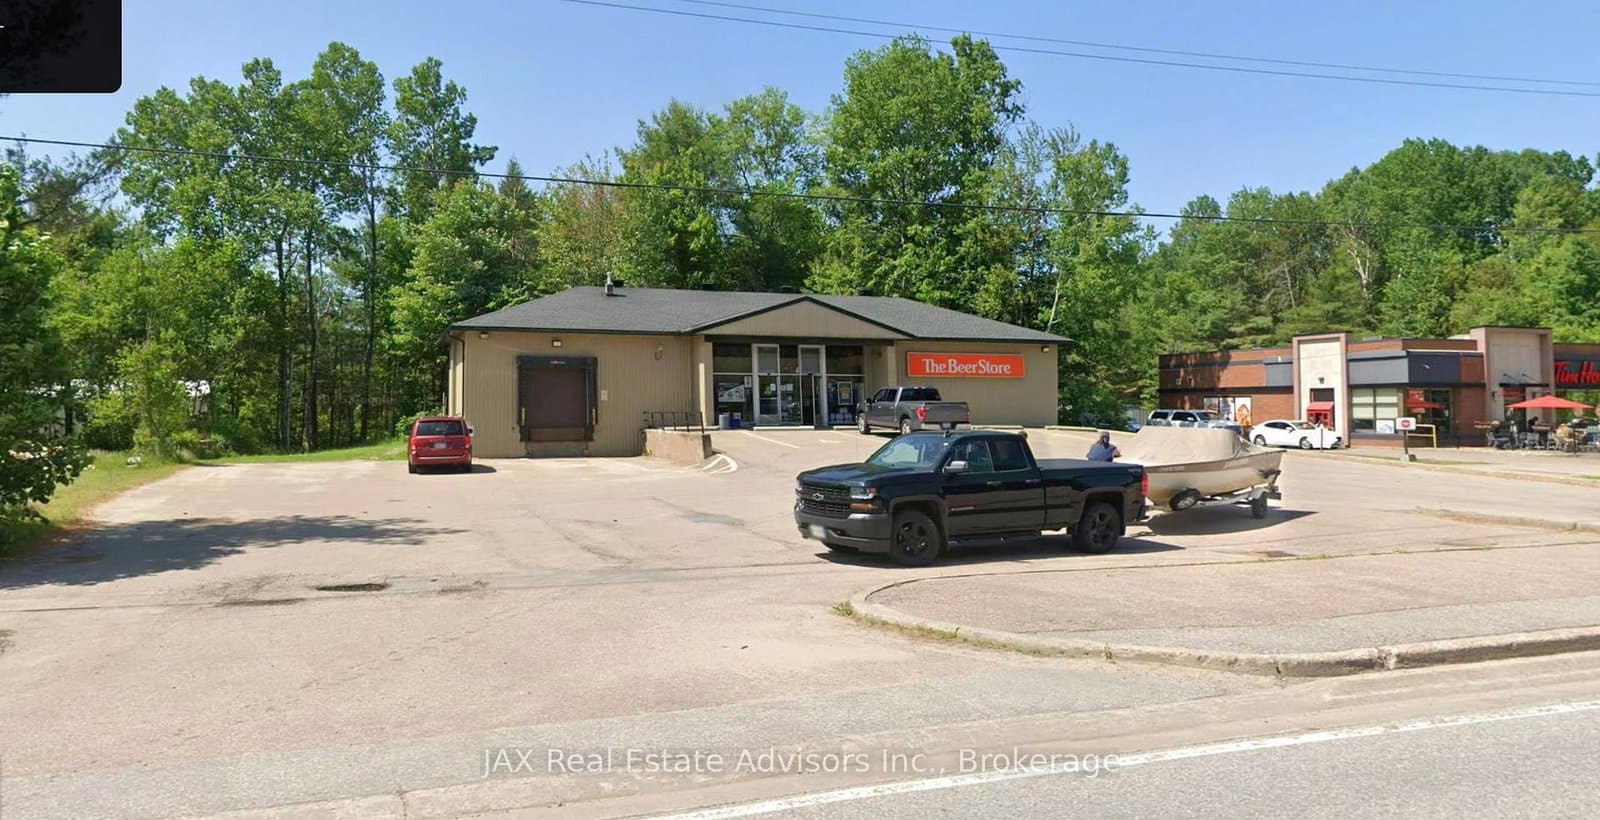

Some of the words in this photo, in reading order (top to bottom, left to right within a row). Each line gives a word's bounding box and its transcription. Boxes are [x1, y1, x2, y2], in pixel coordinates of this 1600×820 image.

[922, 358, 946, 374] The
[948, 358, 978, 374] Beer
[978, 359, 1011, 375] Store
[1553, 361, 1578, 384] Tim
